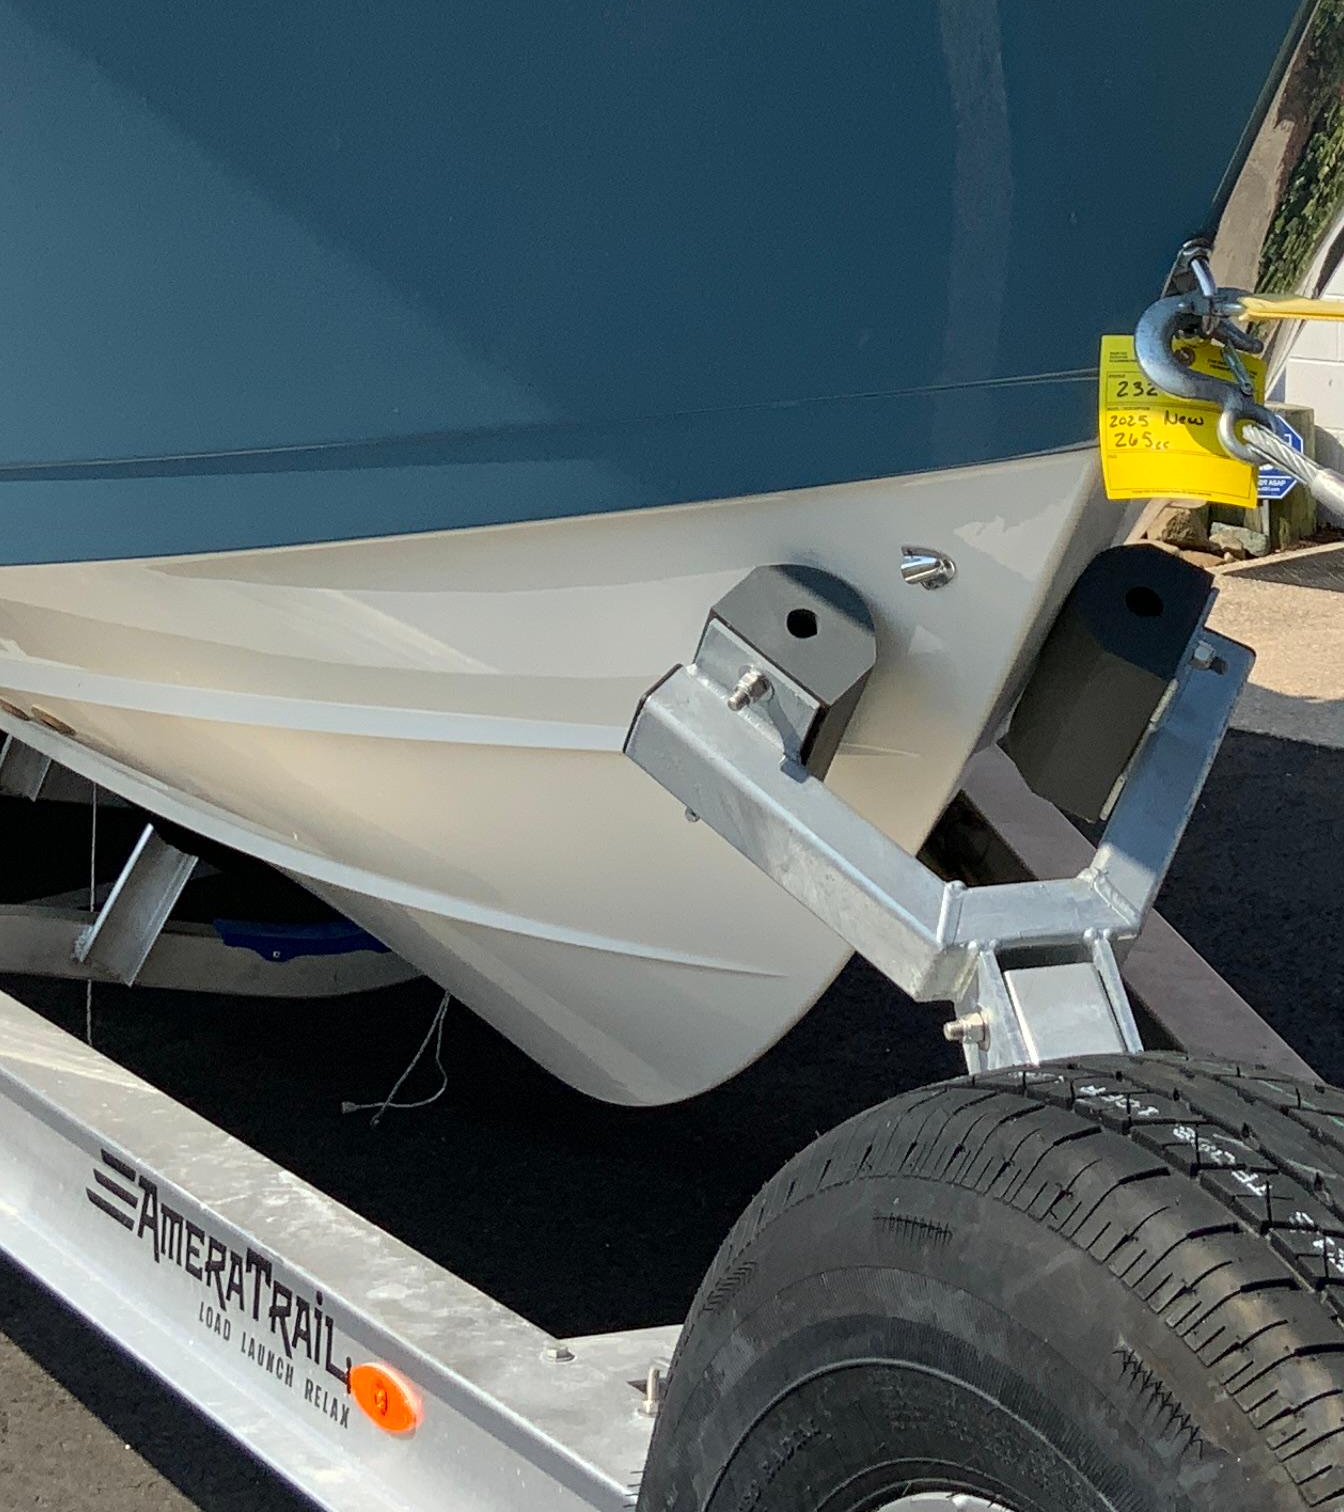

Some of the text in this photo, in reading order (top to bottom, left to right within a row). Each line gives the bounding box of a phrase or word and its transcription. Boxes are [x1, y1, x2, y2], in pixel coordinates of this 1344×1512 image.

[1109, 409, 1205, 429] 2025 New
[198, 1300, 352, 1429] LOAD LAUNCH RELAX
